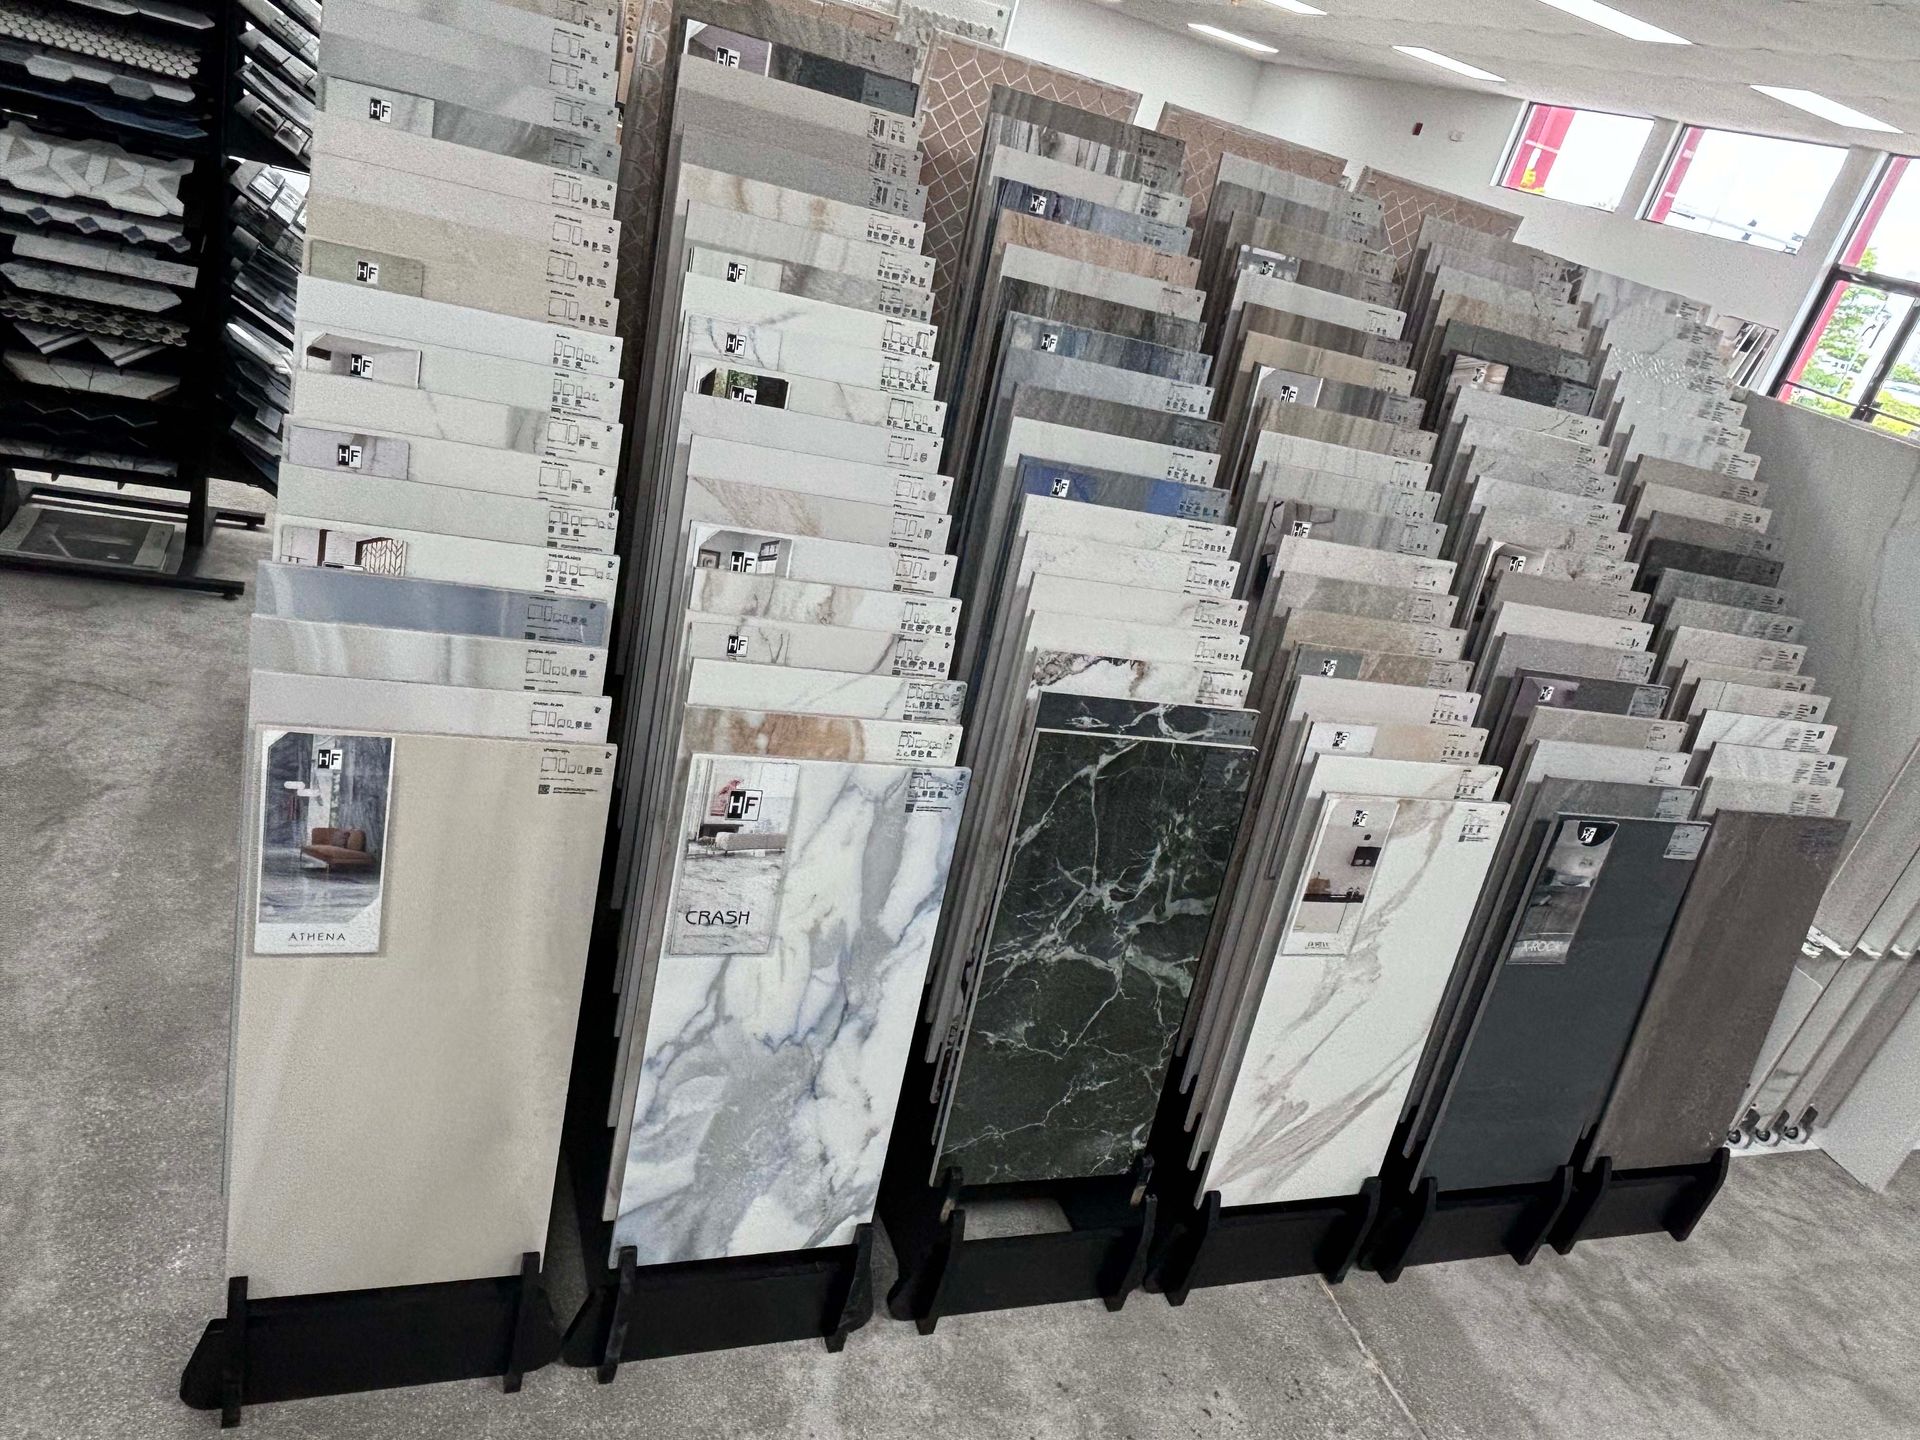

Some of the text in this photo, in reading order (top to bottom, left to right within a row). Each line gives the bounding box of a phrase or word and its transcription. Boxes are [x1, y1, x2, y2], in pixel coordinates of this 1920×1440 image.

[716, 50, 738, 67] HF
[369, 101, 391, 119] HF
[357, 264, 378, 281] HF
[726, 265, 746, 281] HF
[726, 336, 745, 352] HF
[351, 356, 373, 375] HF
[338, 447, 362, 464] HF
[730, 553, 756, 573] HF
[727, 636, 747, 652] HF
[317, 751, 342, 767] HF
[729, 796, 759, 815] HF
[685, 910, 750, 926] CRASH
[288, 932, 346, 941] ATHENA
